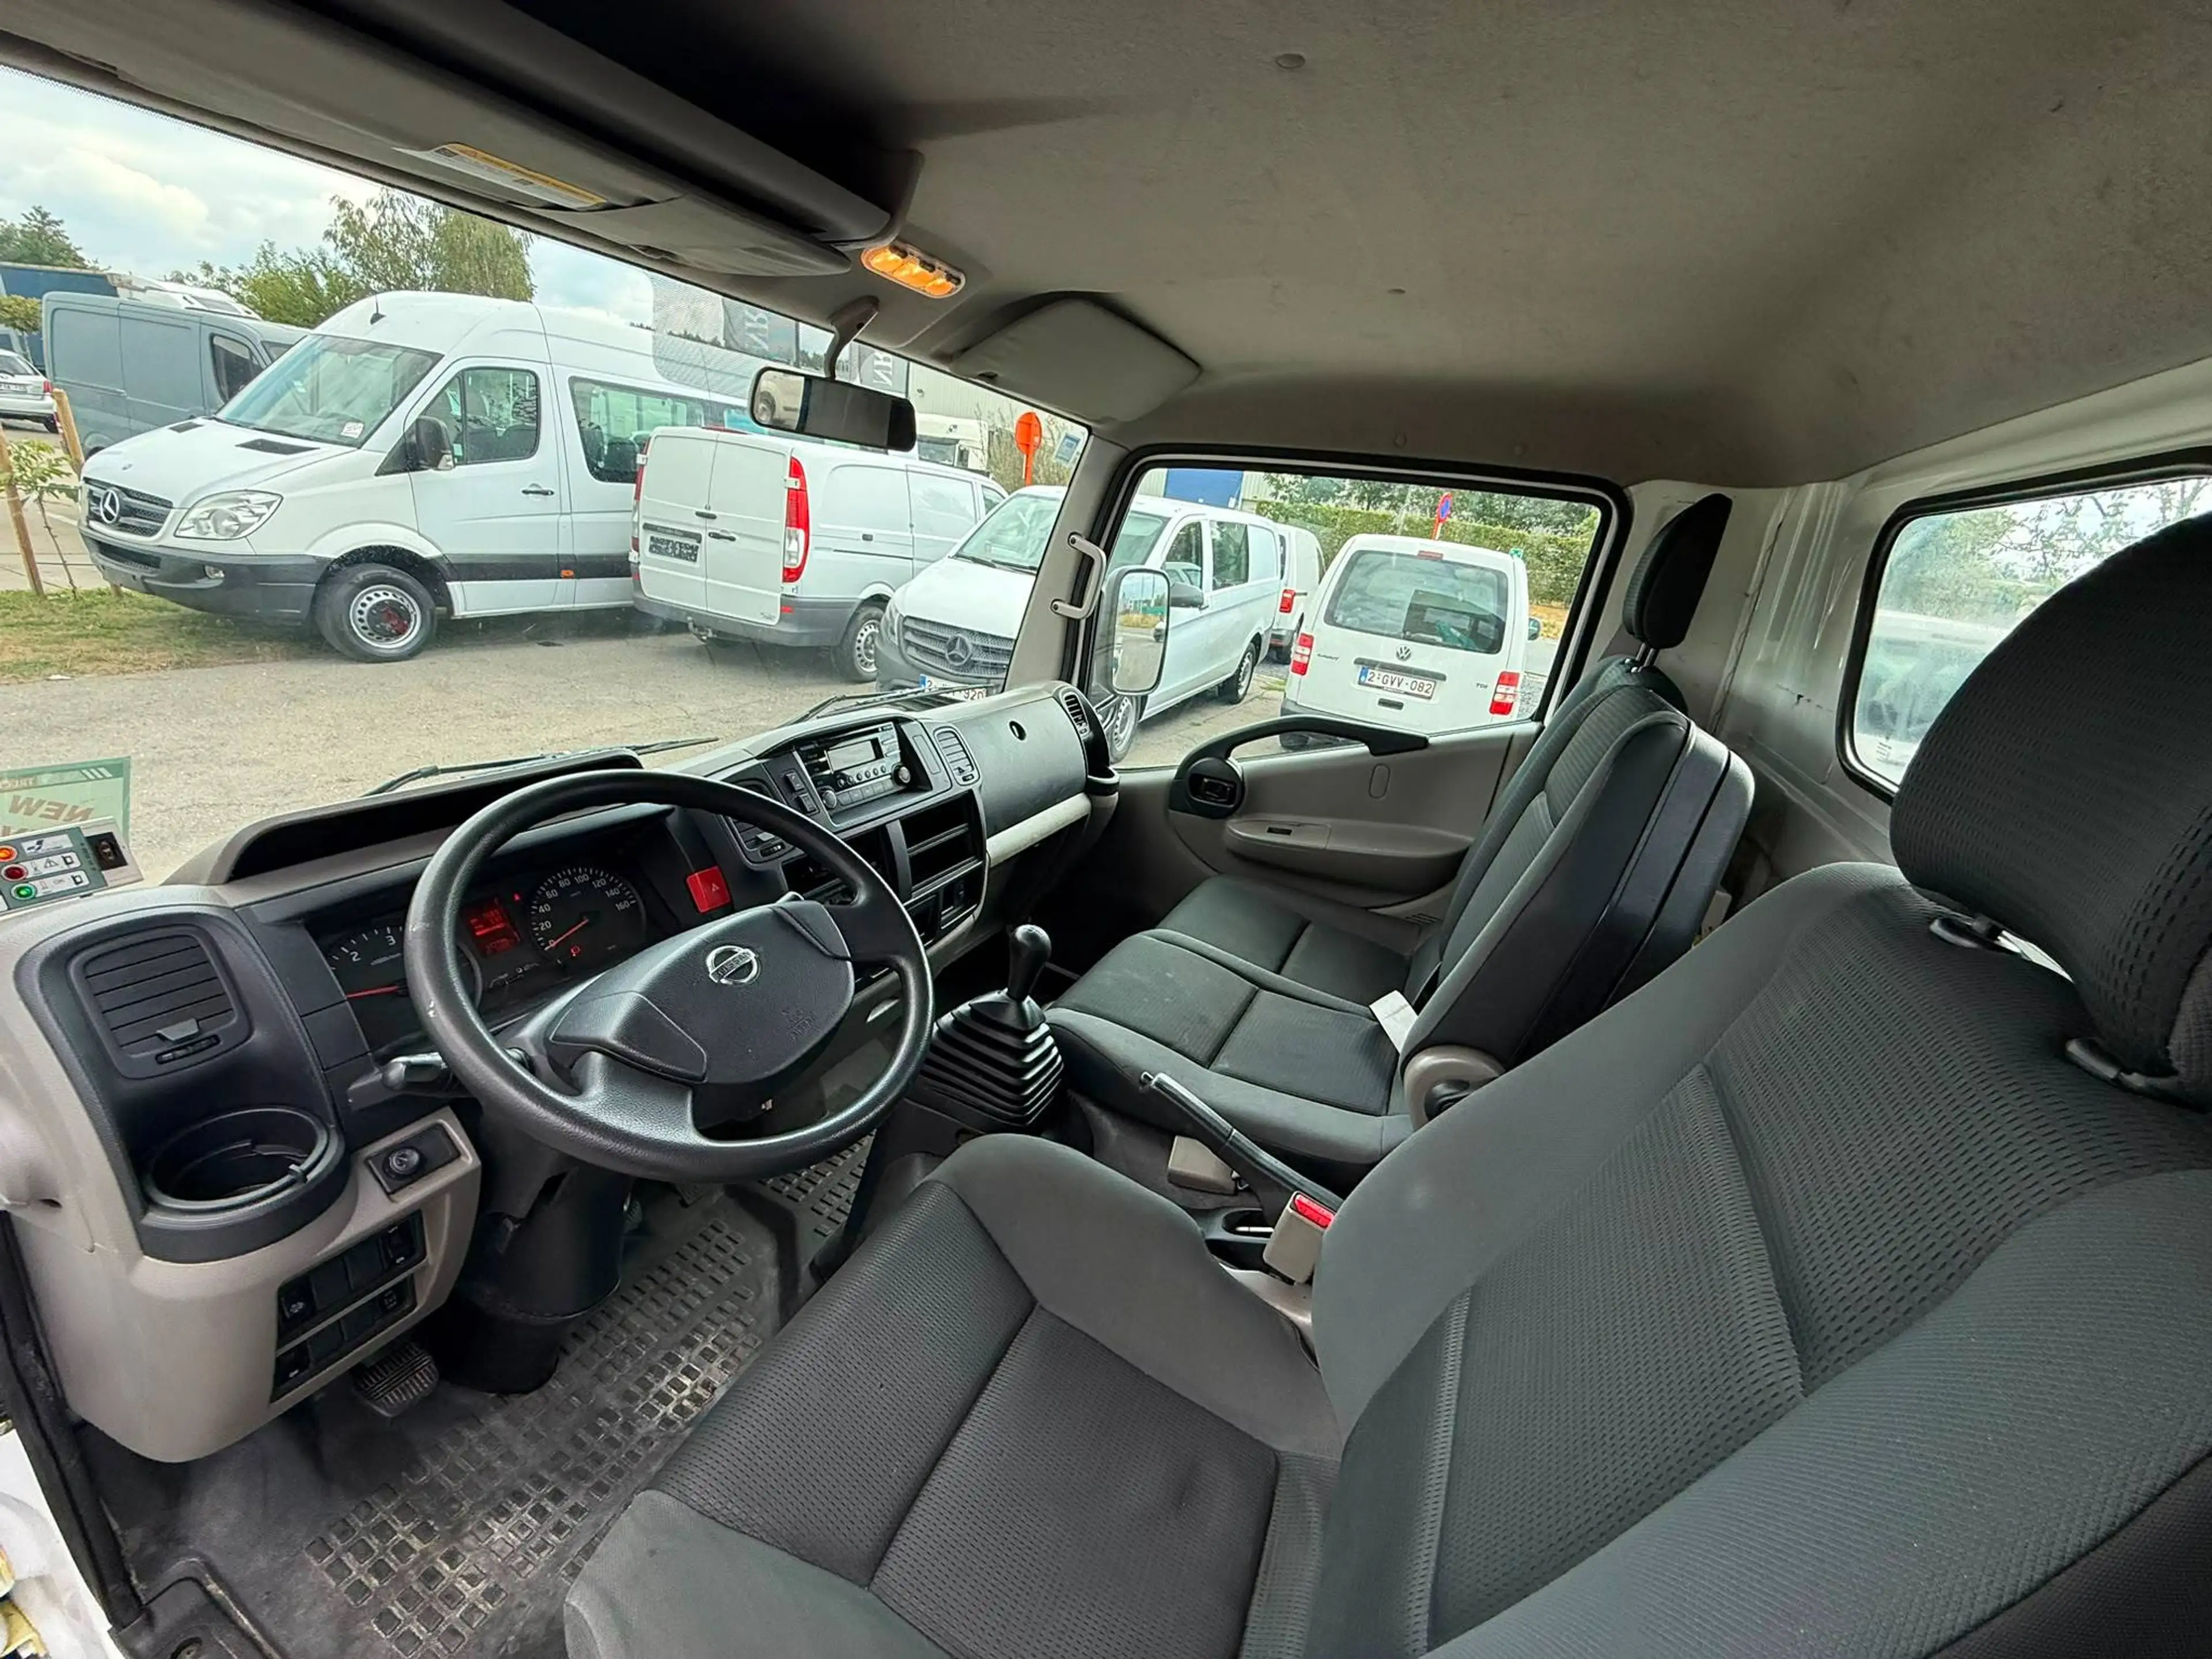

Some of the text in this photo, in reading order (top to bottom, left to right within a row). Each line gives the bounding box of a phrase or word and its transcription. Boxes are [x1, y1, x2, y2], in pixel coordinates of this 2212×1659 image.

[558, 878, 571, 888] 80
[574, 874, 589, 884] 100
[592, 878, 607, 888] 120
[546, 889, 558, 899] 60
[605, 888, 620, 897] 140
[539, 903, 551, 912] 40
[615, 900, 630, 911] 160
[539, 921, 552, 931] 20
[385, 935, 396, 946] 3
[350, 951, 362, 962] 2
